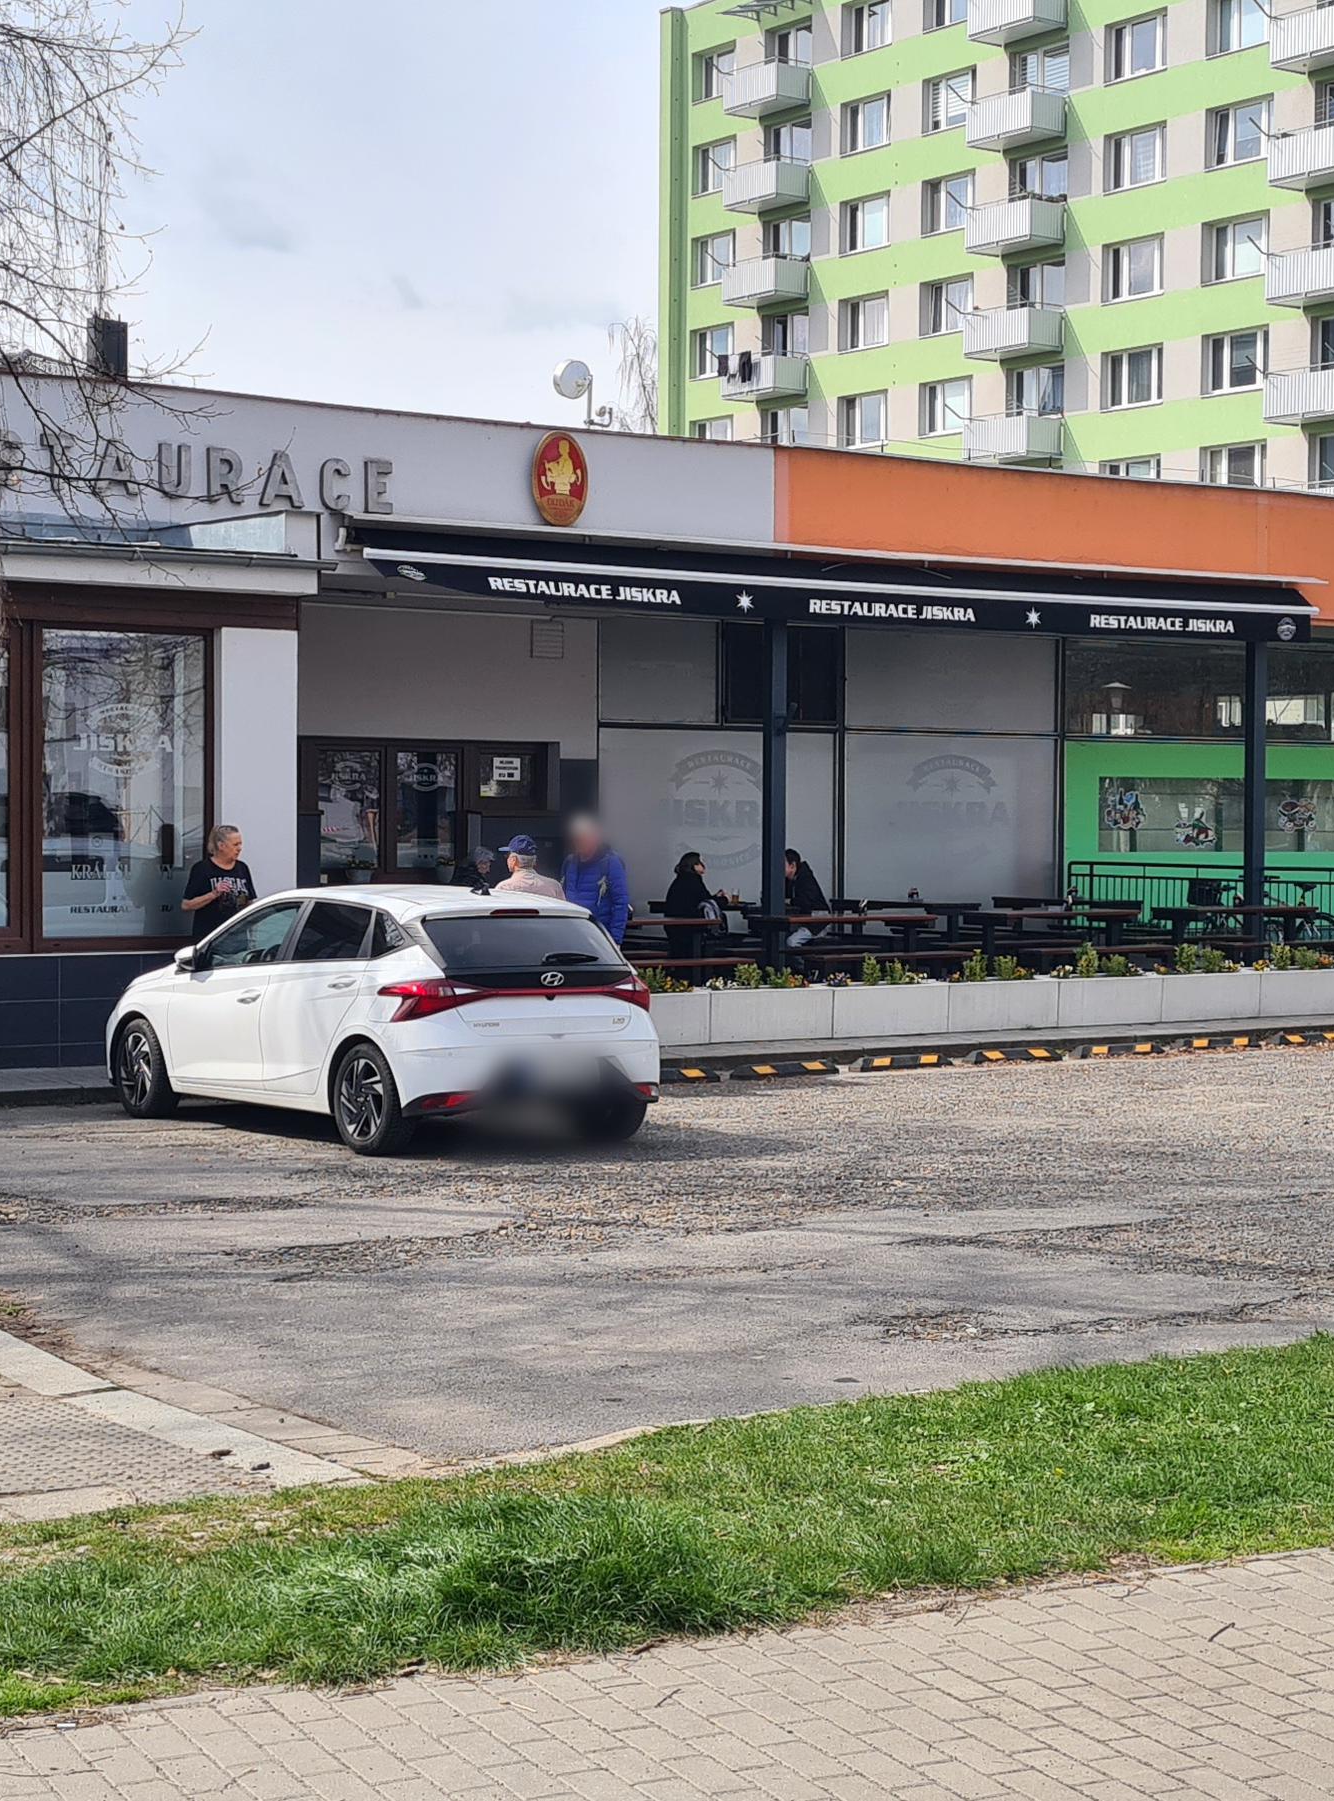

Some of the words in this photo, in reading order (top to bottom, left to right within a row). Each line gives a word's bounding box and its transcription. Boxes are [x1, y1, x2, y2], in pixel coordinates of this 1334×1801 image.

[487, 576, 613, 600] RESTAURACE
[615, 585, 682, 605] JISKRA
[808, 598, 918, 619] RESTAURACE
[919, 604, 976, 622] JISKRA
[1089, 613, 1184, 631] RESTAURACE
[1185, 618, 1235, 634] JISKRA
[73, 732, 173, 752] JISKRA
